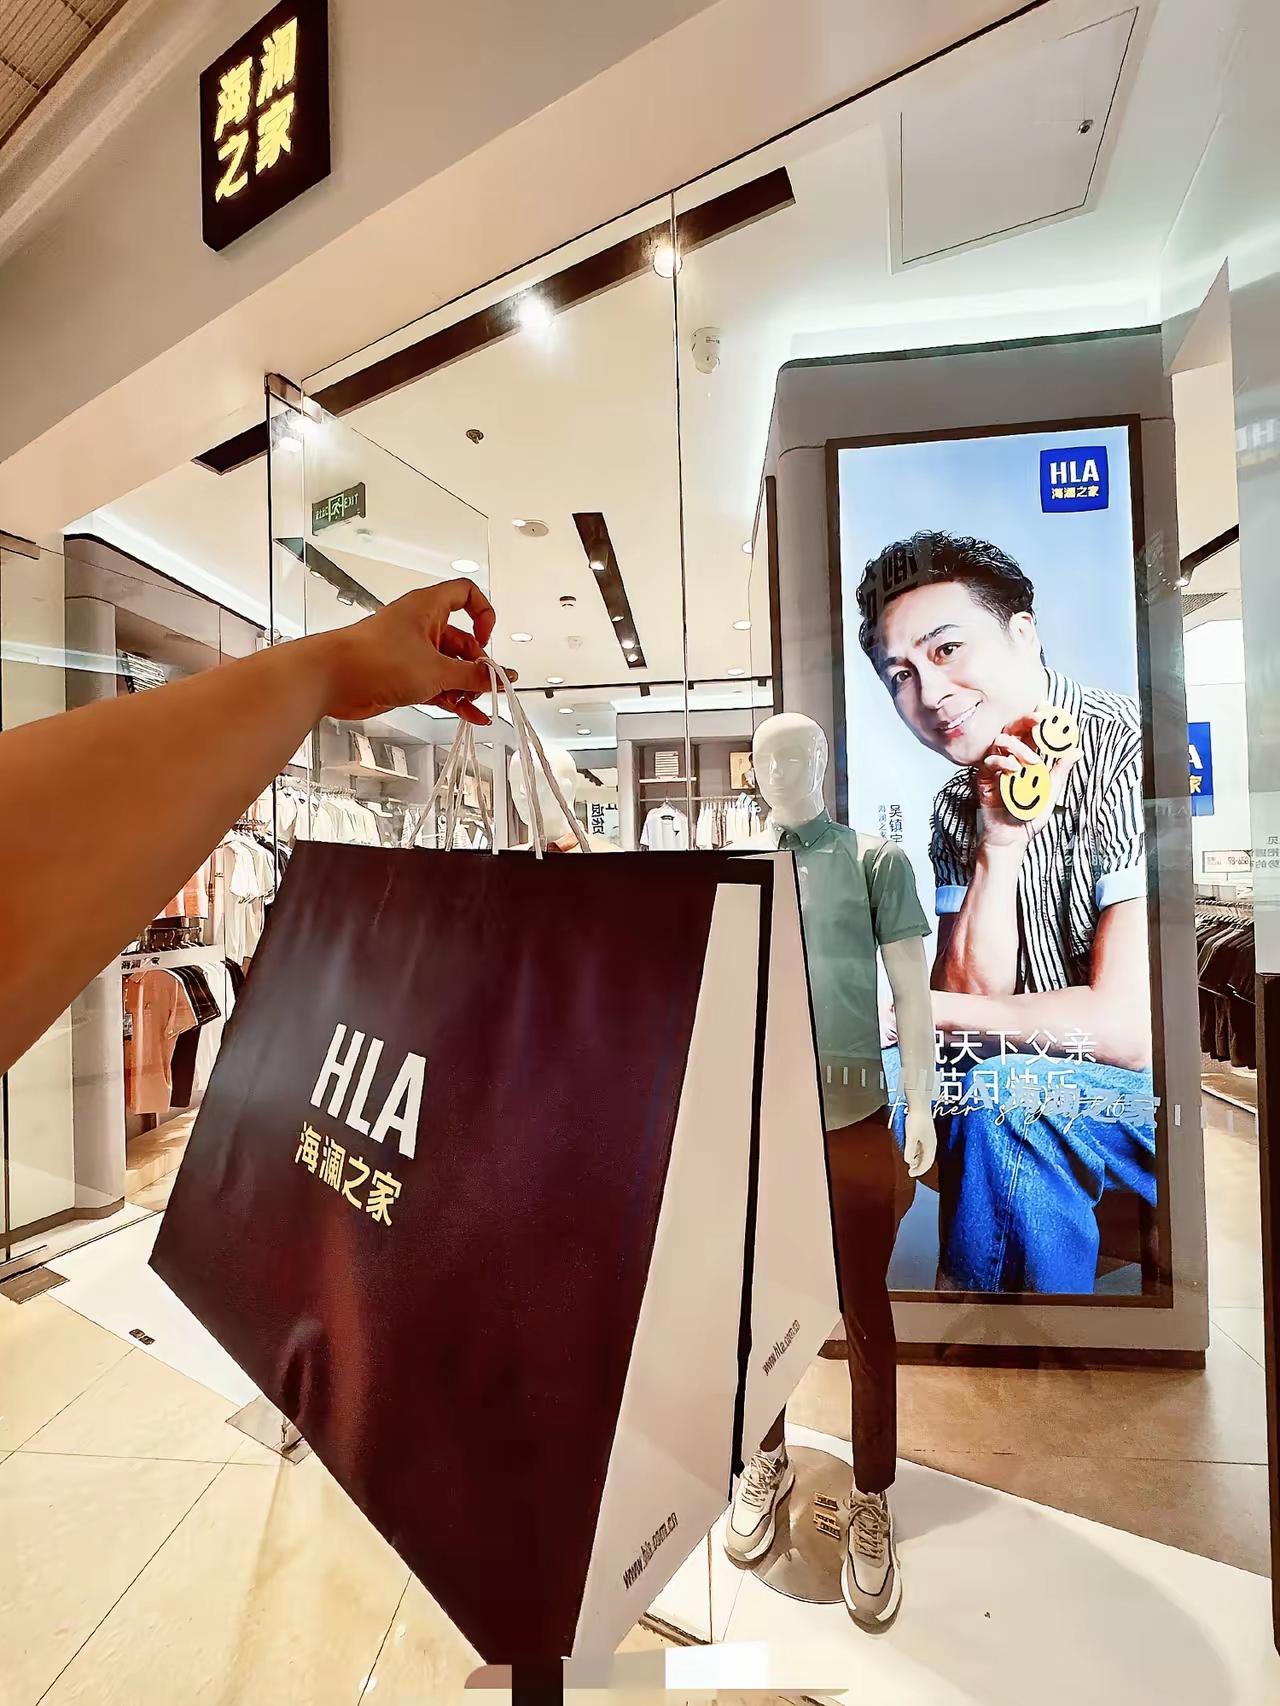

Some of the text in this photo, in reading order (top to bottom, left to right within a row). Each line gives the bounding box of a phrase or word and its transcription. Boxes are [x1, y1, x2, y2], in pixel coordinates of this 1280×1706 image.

[214, 17, 298, 141] 海澜
[215, 92, 295, 203] 之家
[1050, 459, 1100, 485] HLA
[1051, 485, 1099, 500] 海澜之家
[310, 1022, 427, 1160] HLA
[294, 1121, 403, 1227] 海澜之家
